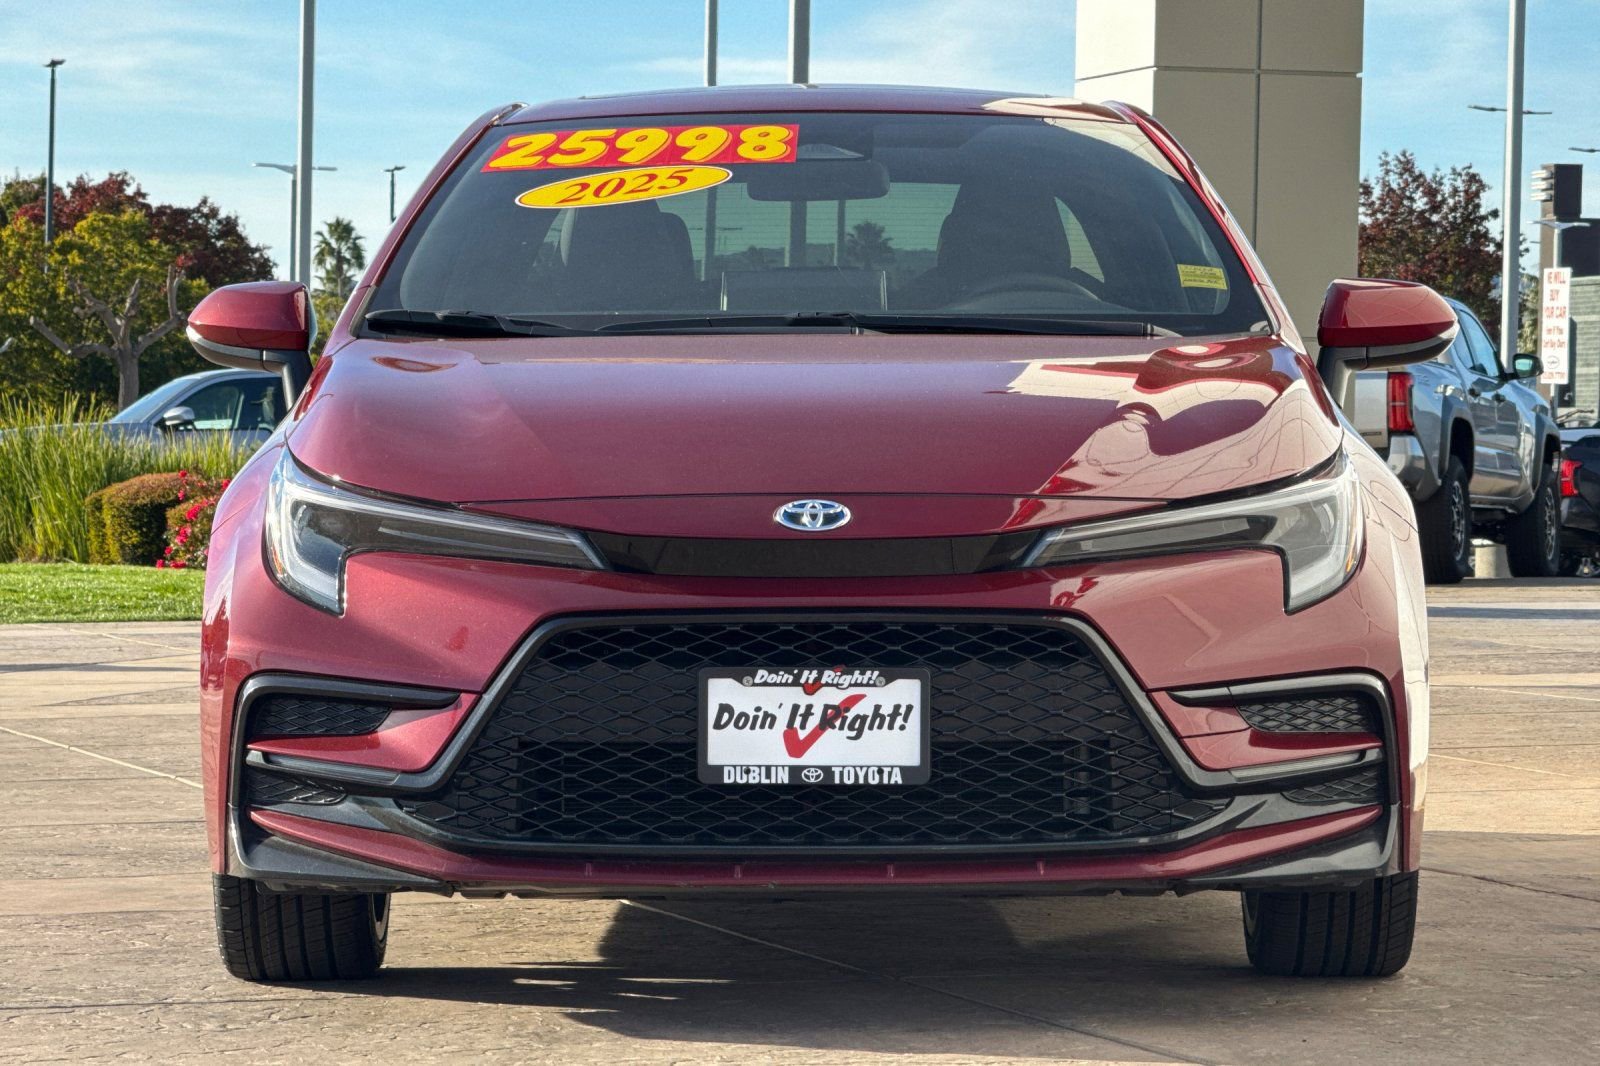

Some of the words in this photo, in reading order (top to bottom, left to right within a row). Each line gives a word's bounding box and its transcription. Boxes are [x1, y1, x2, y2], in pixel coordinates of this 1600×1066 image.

[489, 125, 790, 168] 25998
[555, 169, 695, 204] 2025
[754, 669, 798, 684] Doin'
[800, 669, 818, 684] It
[821, 669, 879, 689] Right!
[712, 702, 783, 731] Doin'
[786, 703, 814, 730] It
[819, 703, 914, 741] Right!
[723, 766, 789, 784] DUBLIN
[832, 766, 902, 785] TOYOTA
